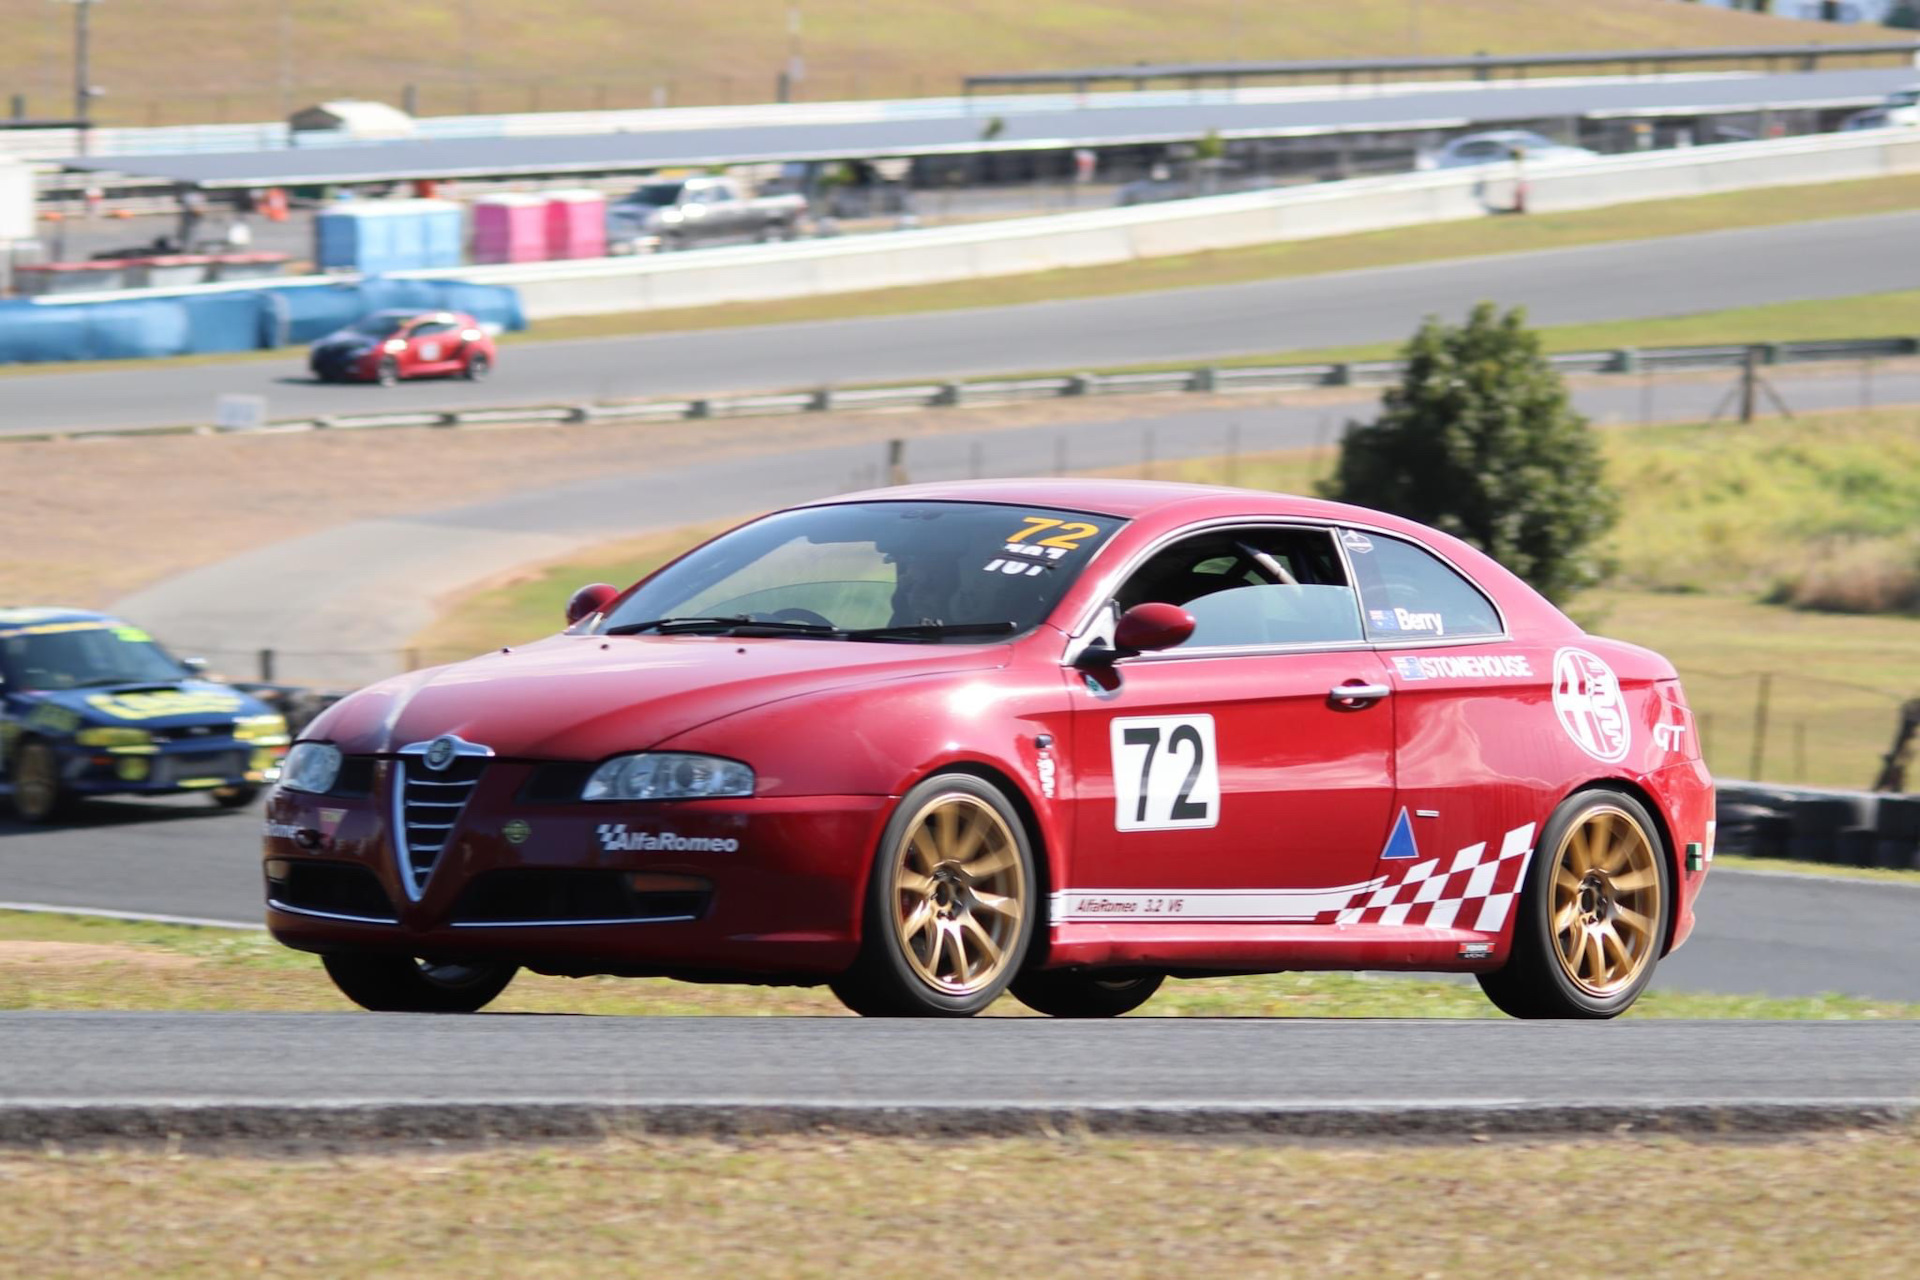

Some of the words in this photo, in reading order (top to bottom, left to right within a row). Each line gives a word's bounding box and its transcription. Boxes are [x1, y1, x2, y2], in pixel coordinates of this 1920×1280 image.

[1005, 516, 1099, 550] 72
[1393, 607, 1444, 635] Berry
[1419, 655, 1533, 678] STONEHOUSE
[1653, 723, 1686, 751] GT
[1123, 723, 1208, 822] 72
[615, 832, 739, 852] AlfaRomeo
[1075, 899, 1138, 913] AlfaRomeo
[1143, 899, 1163, 913] 3.2
[1167, 899, 1185, 913] V6
